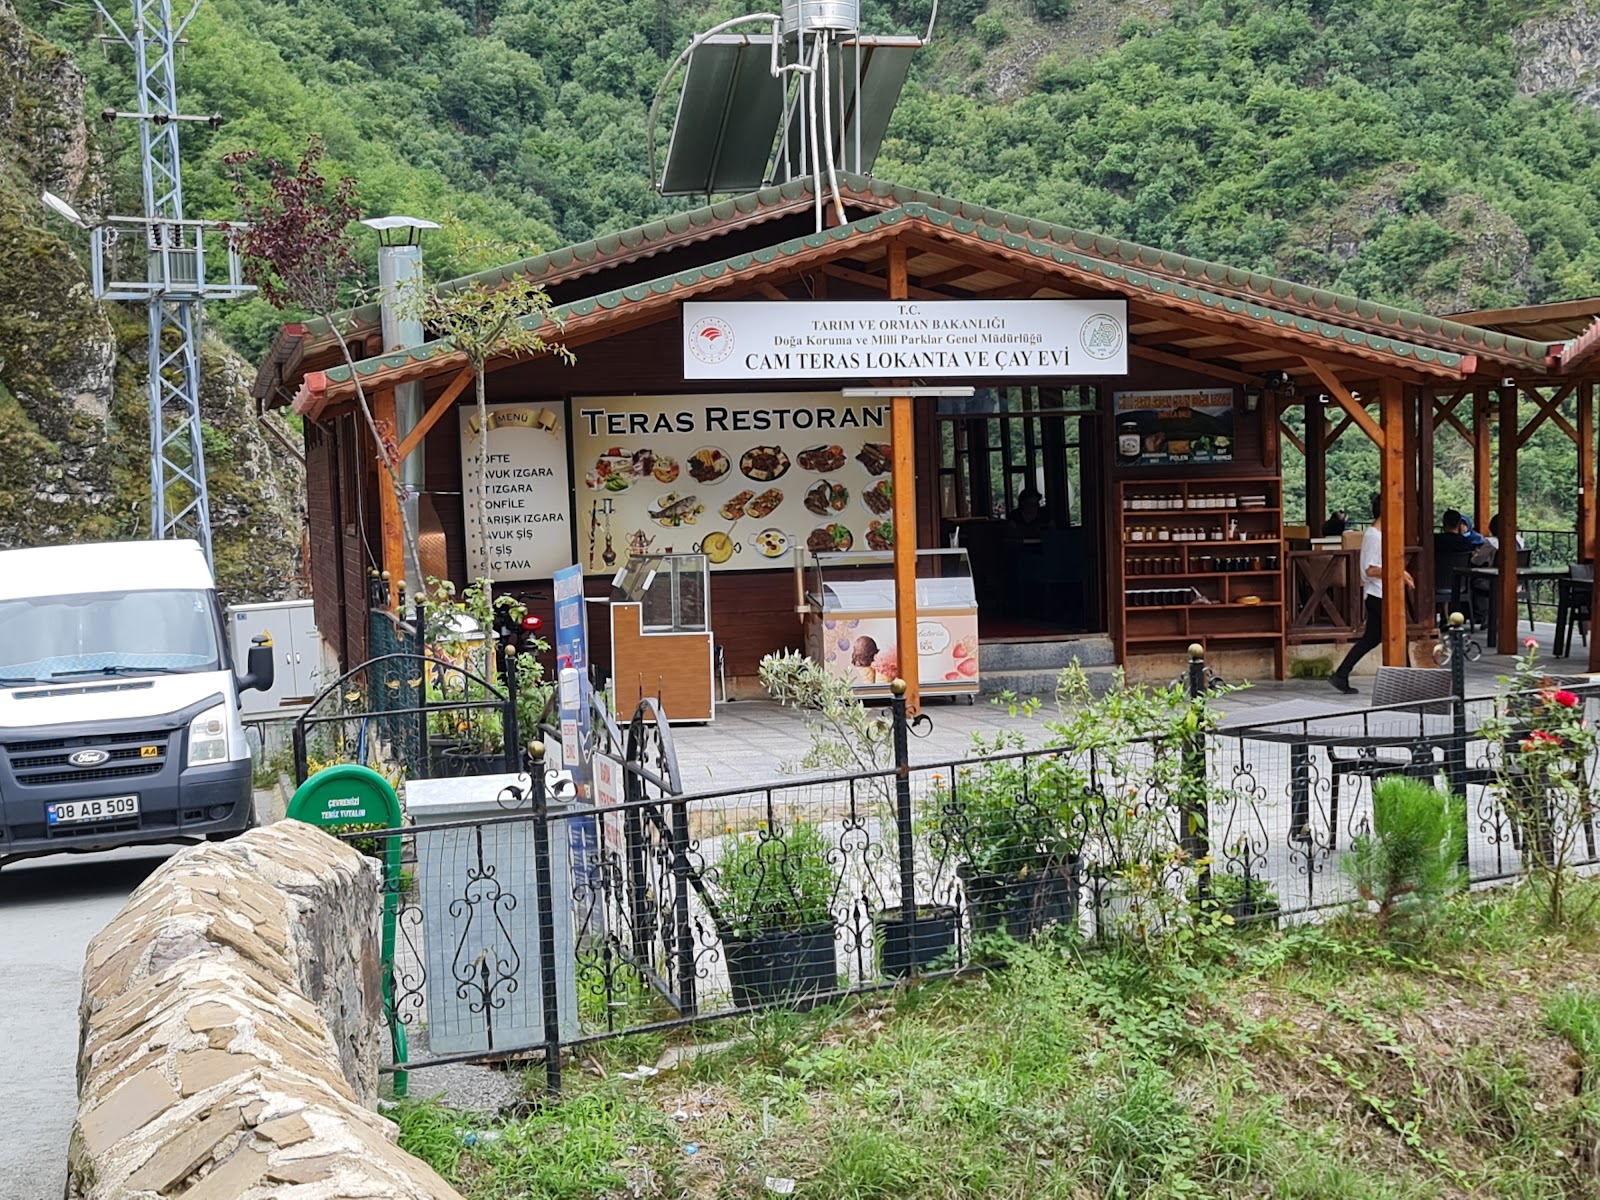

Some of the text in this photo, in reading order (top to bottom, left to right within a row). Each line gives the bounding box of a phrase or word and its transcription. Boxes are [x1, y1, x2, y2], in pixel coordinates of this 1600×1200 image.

[898, 305, 921, 316] T.C.
[812, 316, 1005, 331] TARIM VE ORMAN BAKANLIĞI
[774, 333, 1042, 348] Doğa Koruma ve Milli Parklar Genel Müdürlüğü
[745, 346, 1069, 370] CAM TERAS LOKANTA VE ÇAY EVİ
[581, 410, 694, 435] TERAS
[513, 468, 553, 478] IZGARA
[493, 484, 533, 494] IZGARA
[478, 498, 525, 509] ONFİLE
[478, 513, 564, 526] ARIŞIK IZGARA
[478, 528, 533, 540] AVUK ŞİŞ
[496, 544, 512, 557] ŞİŞ
[504, 560, 531, 569] TAVA
[77, 752, 101, 763] Ford
[143, 747, 156, 756] AA
[56, 805, 75, 819] 08
[81, 802, 102, 817] AB
[107, 799, 134, 814] 509
